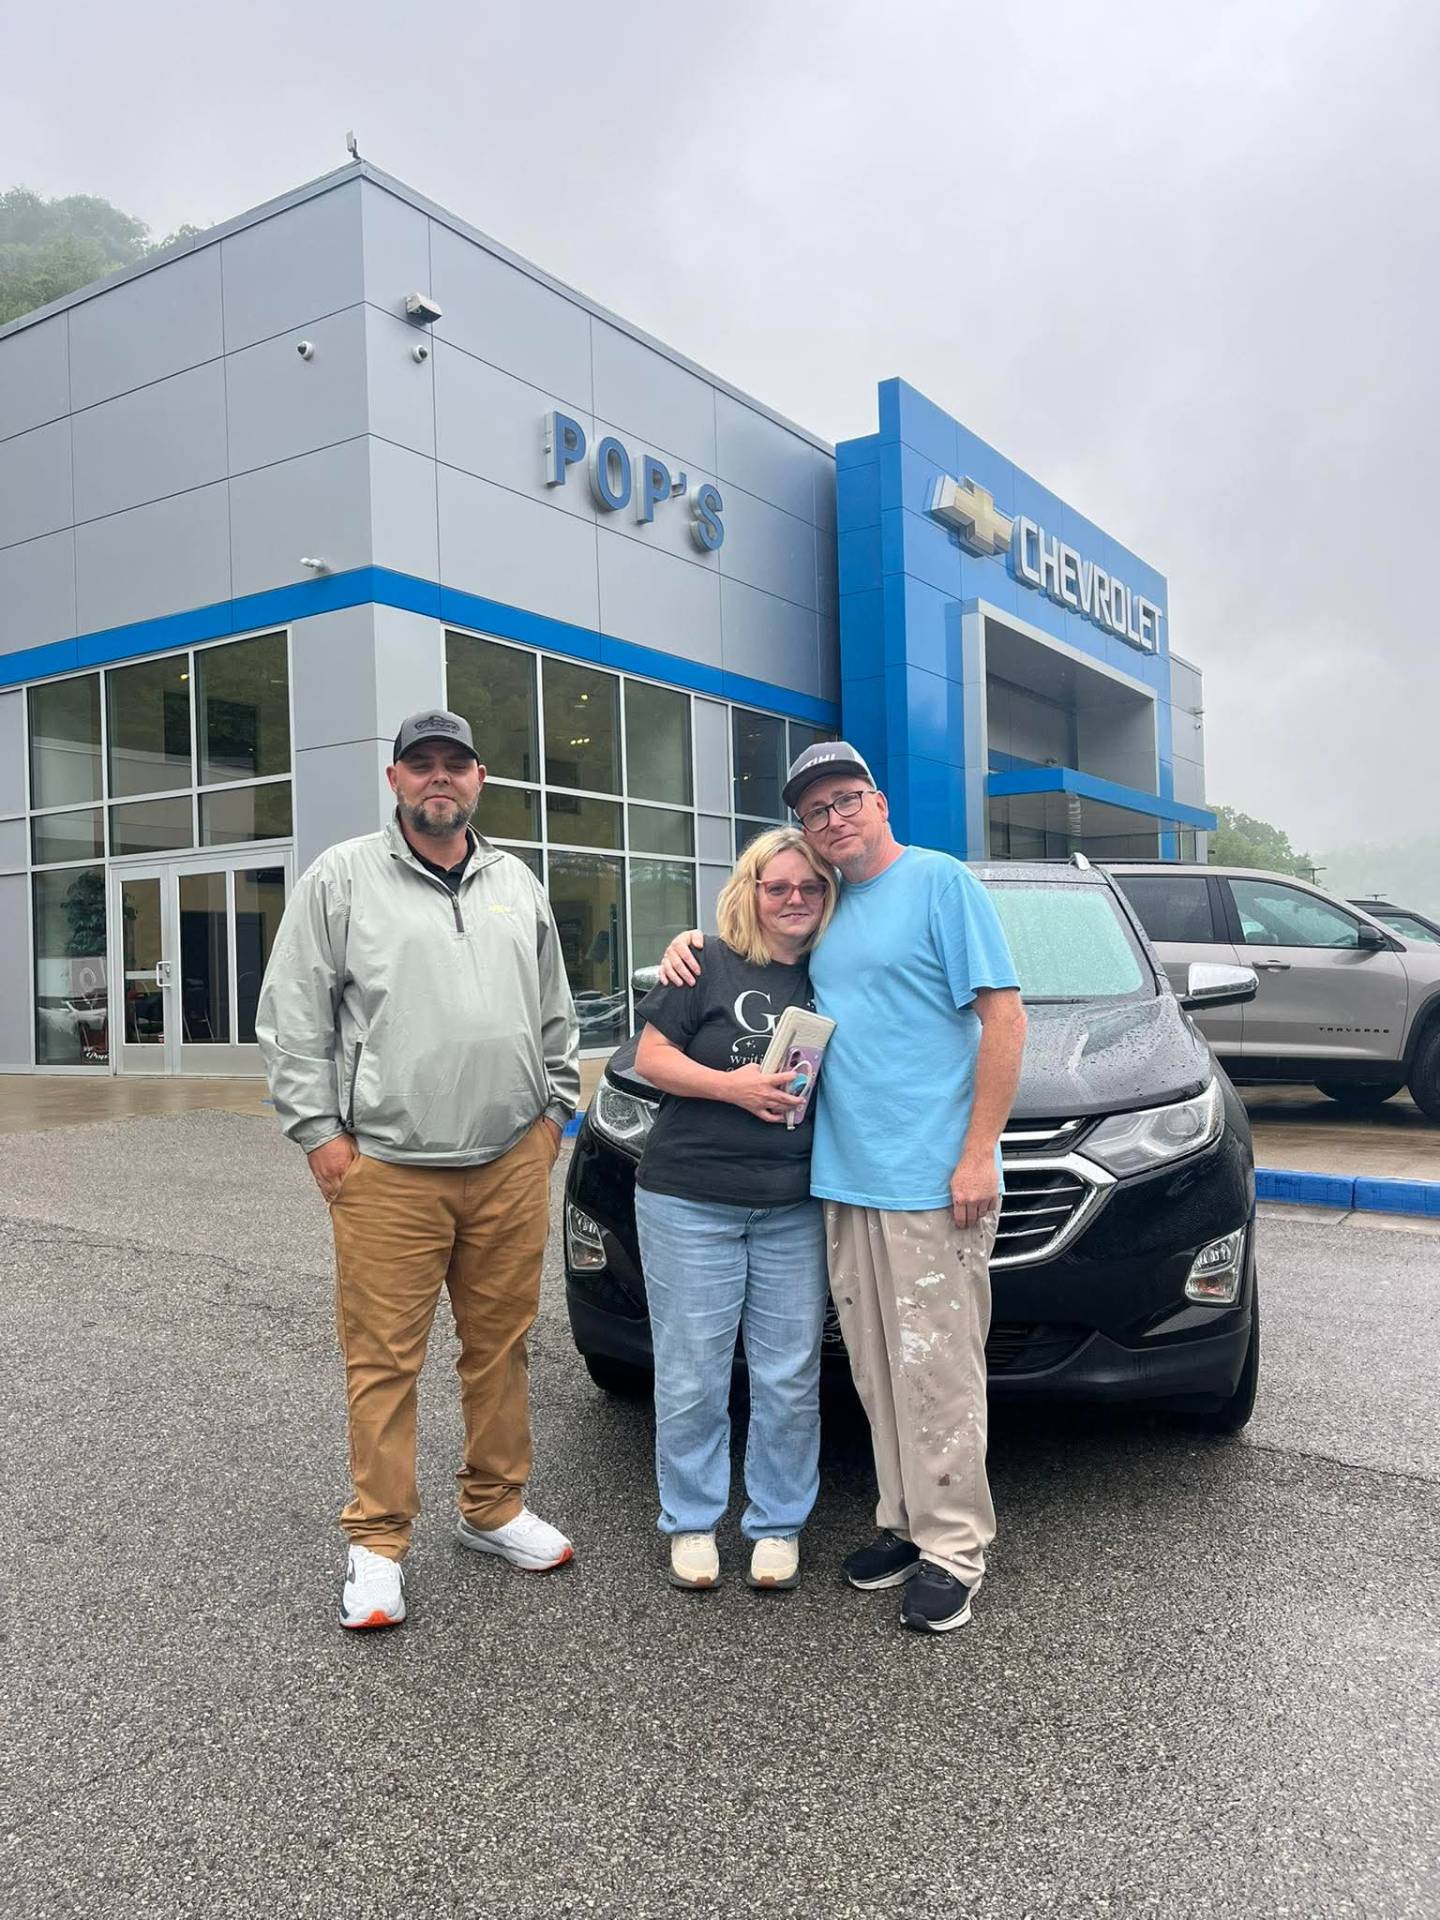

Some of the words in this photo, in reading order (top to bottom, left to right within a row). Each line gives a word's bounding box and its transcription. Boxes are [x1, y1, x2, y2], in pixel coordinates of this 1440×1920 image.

[546, 411, 725, 551] POP'S
[1013, 515, 1162, 655] CHEVROLET
[730, 1053, 764, 1065] writi
[1319, 1026, 1390, 1035] TRAVERSE
